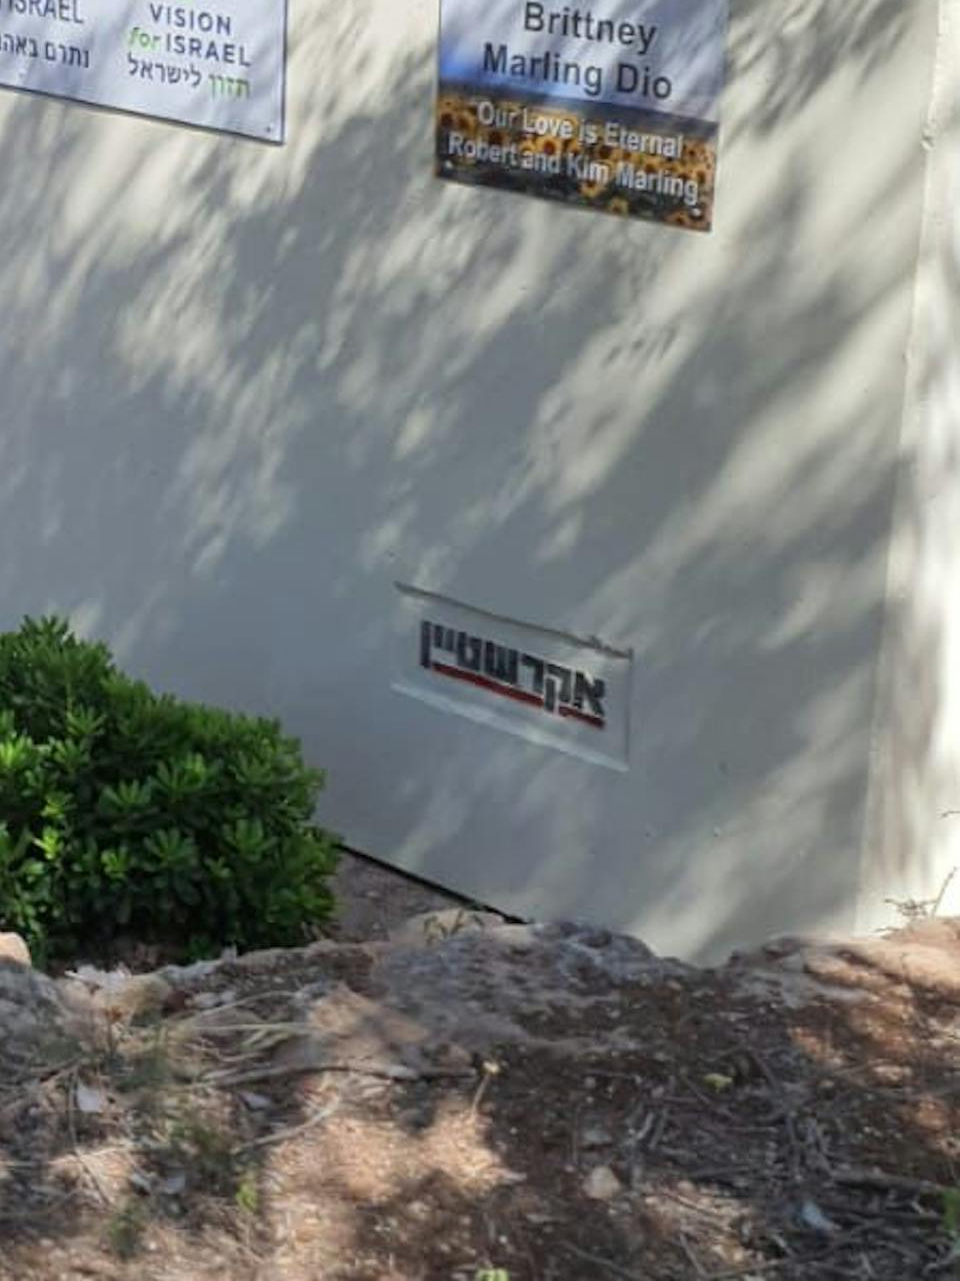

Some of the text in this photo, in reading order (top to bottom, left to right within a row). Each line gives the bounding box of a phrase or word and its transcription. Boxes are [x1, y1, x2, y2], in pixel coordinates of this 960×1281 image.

[149, 2, 232, 36] VISION
[524, 1, 658, 56] Brittney
[45, 40, 90, 68] נתרם
[129, 26, 252, 68] for ISRAEL
[482, 42, 673, 100] Marling Dio
[127, 51, 251, 101] חזון לישראל
[477, 101, 684, 159] Our Love is Eternal
[448, 131, 699, 206] Robert and Kim Marling
[420, 620, 606, 718] אקרשטיין
